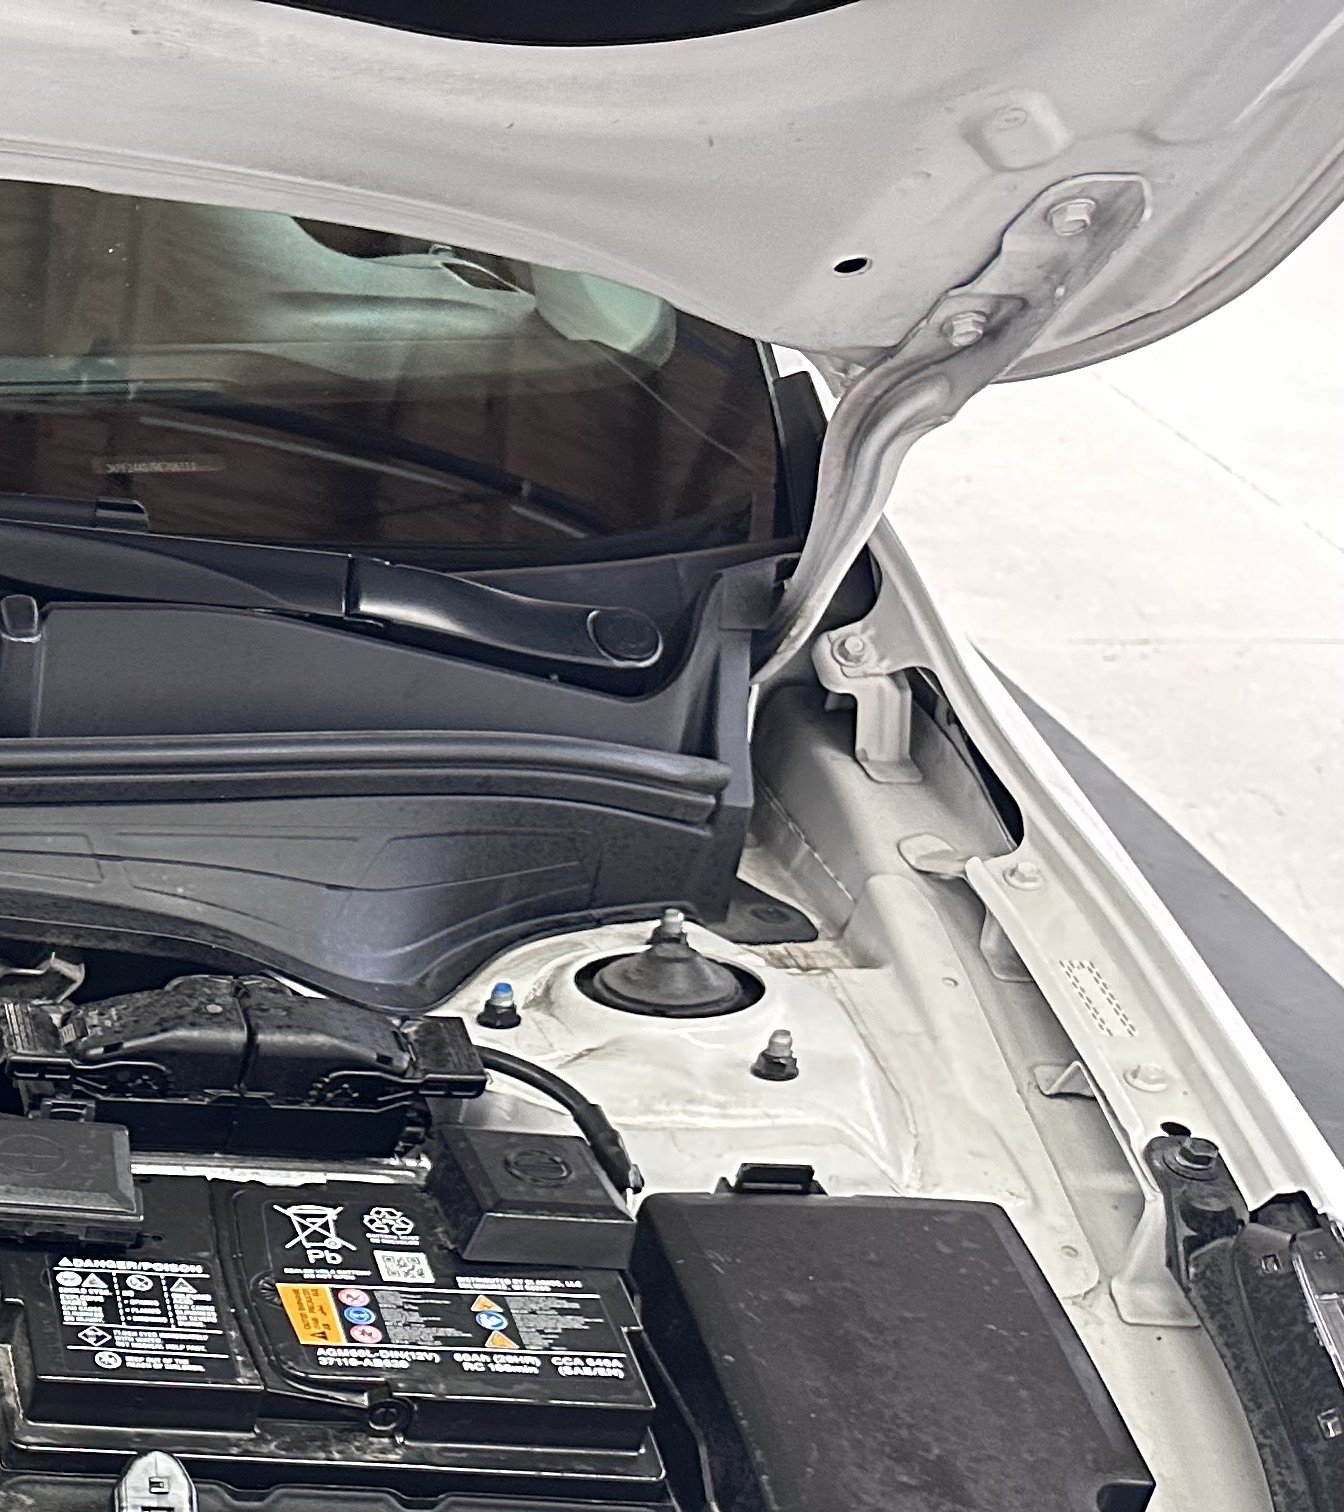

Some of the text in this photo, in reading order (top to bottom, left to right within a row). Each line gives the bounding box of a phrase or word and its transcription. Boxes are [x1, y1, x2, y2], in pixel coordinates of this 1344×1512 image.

[306, 1249, 343, 1266] Pb
[72, 1258, 204, 1274] DANGER/POISON
[551, 1356, 585, 1367] CCA
